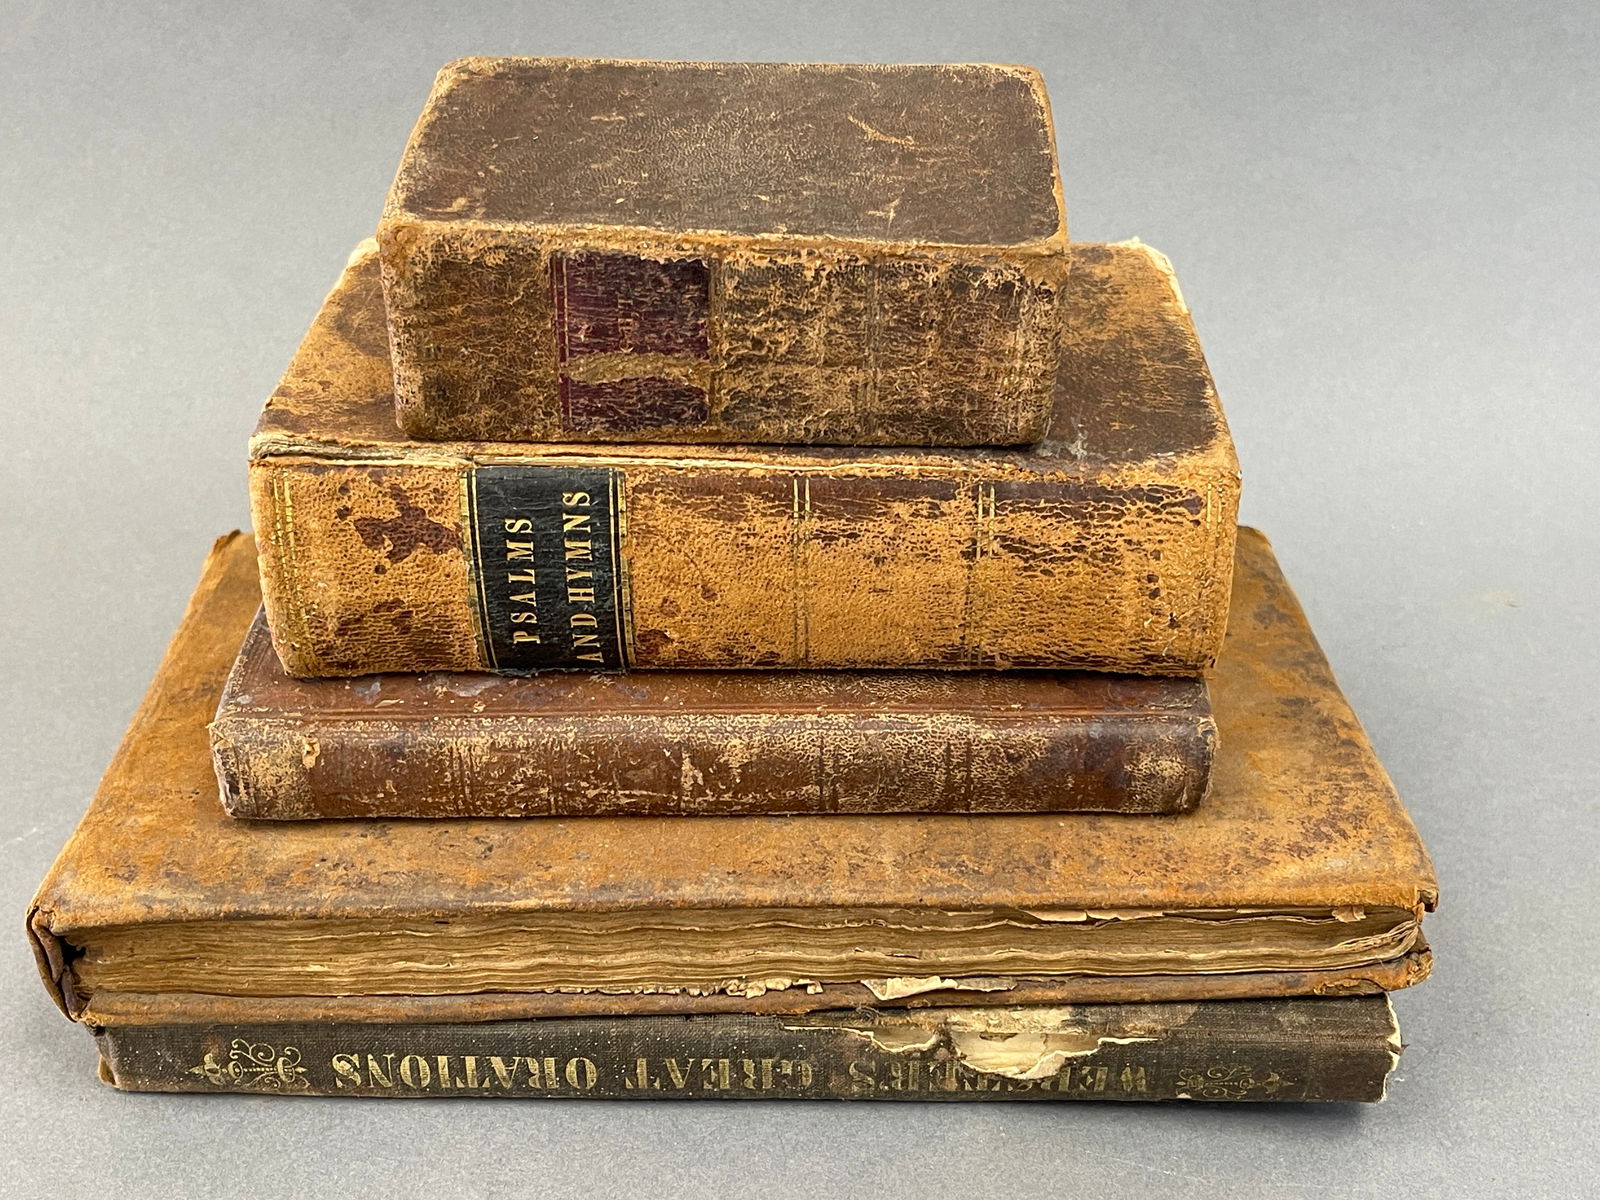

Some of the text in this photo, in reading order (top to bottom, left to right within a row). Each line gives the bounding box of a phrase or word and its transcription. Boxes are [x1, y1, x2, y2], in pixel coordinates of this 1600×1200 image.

[504, 518, 542, 645] PSALMS
[562, 490, 605, 664] AND HYMNS
[331, 1052, 598, 1089] ORATIONS
[624, 1057, 813, 1090] GREAT
